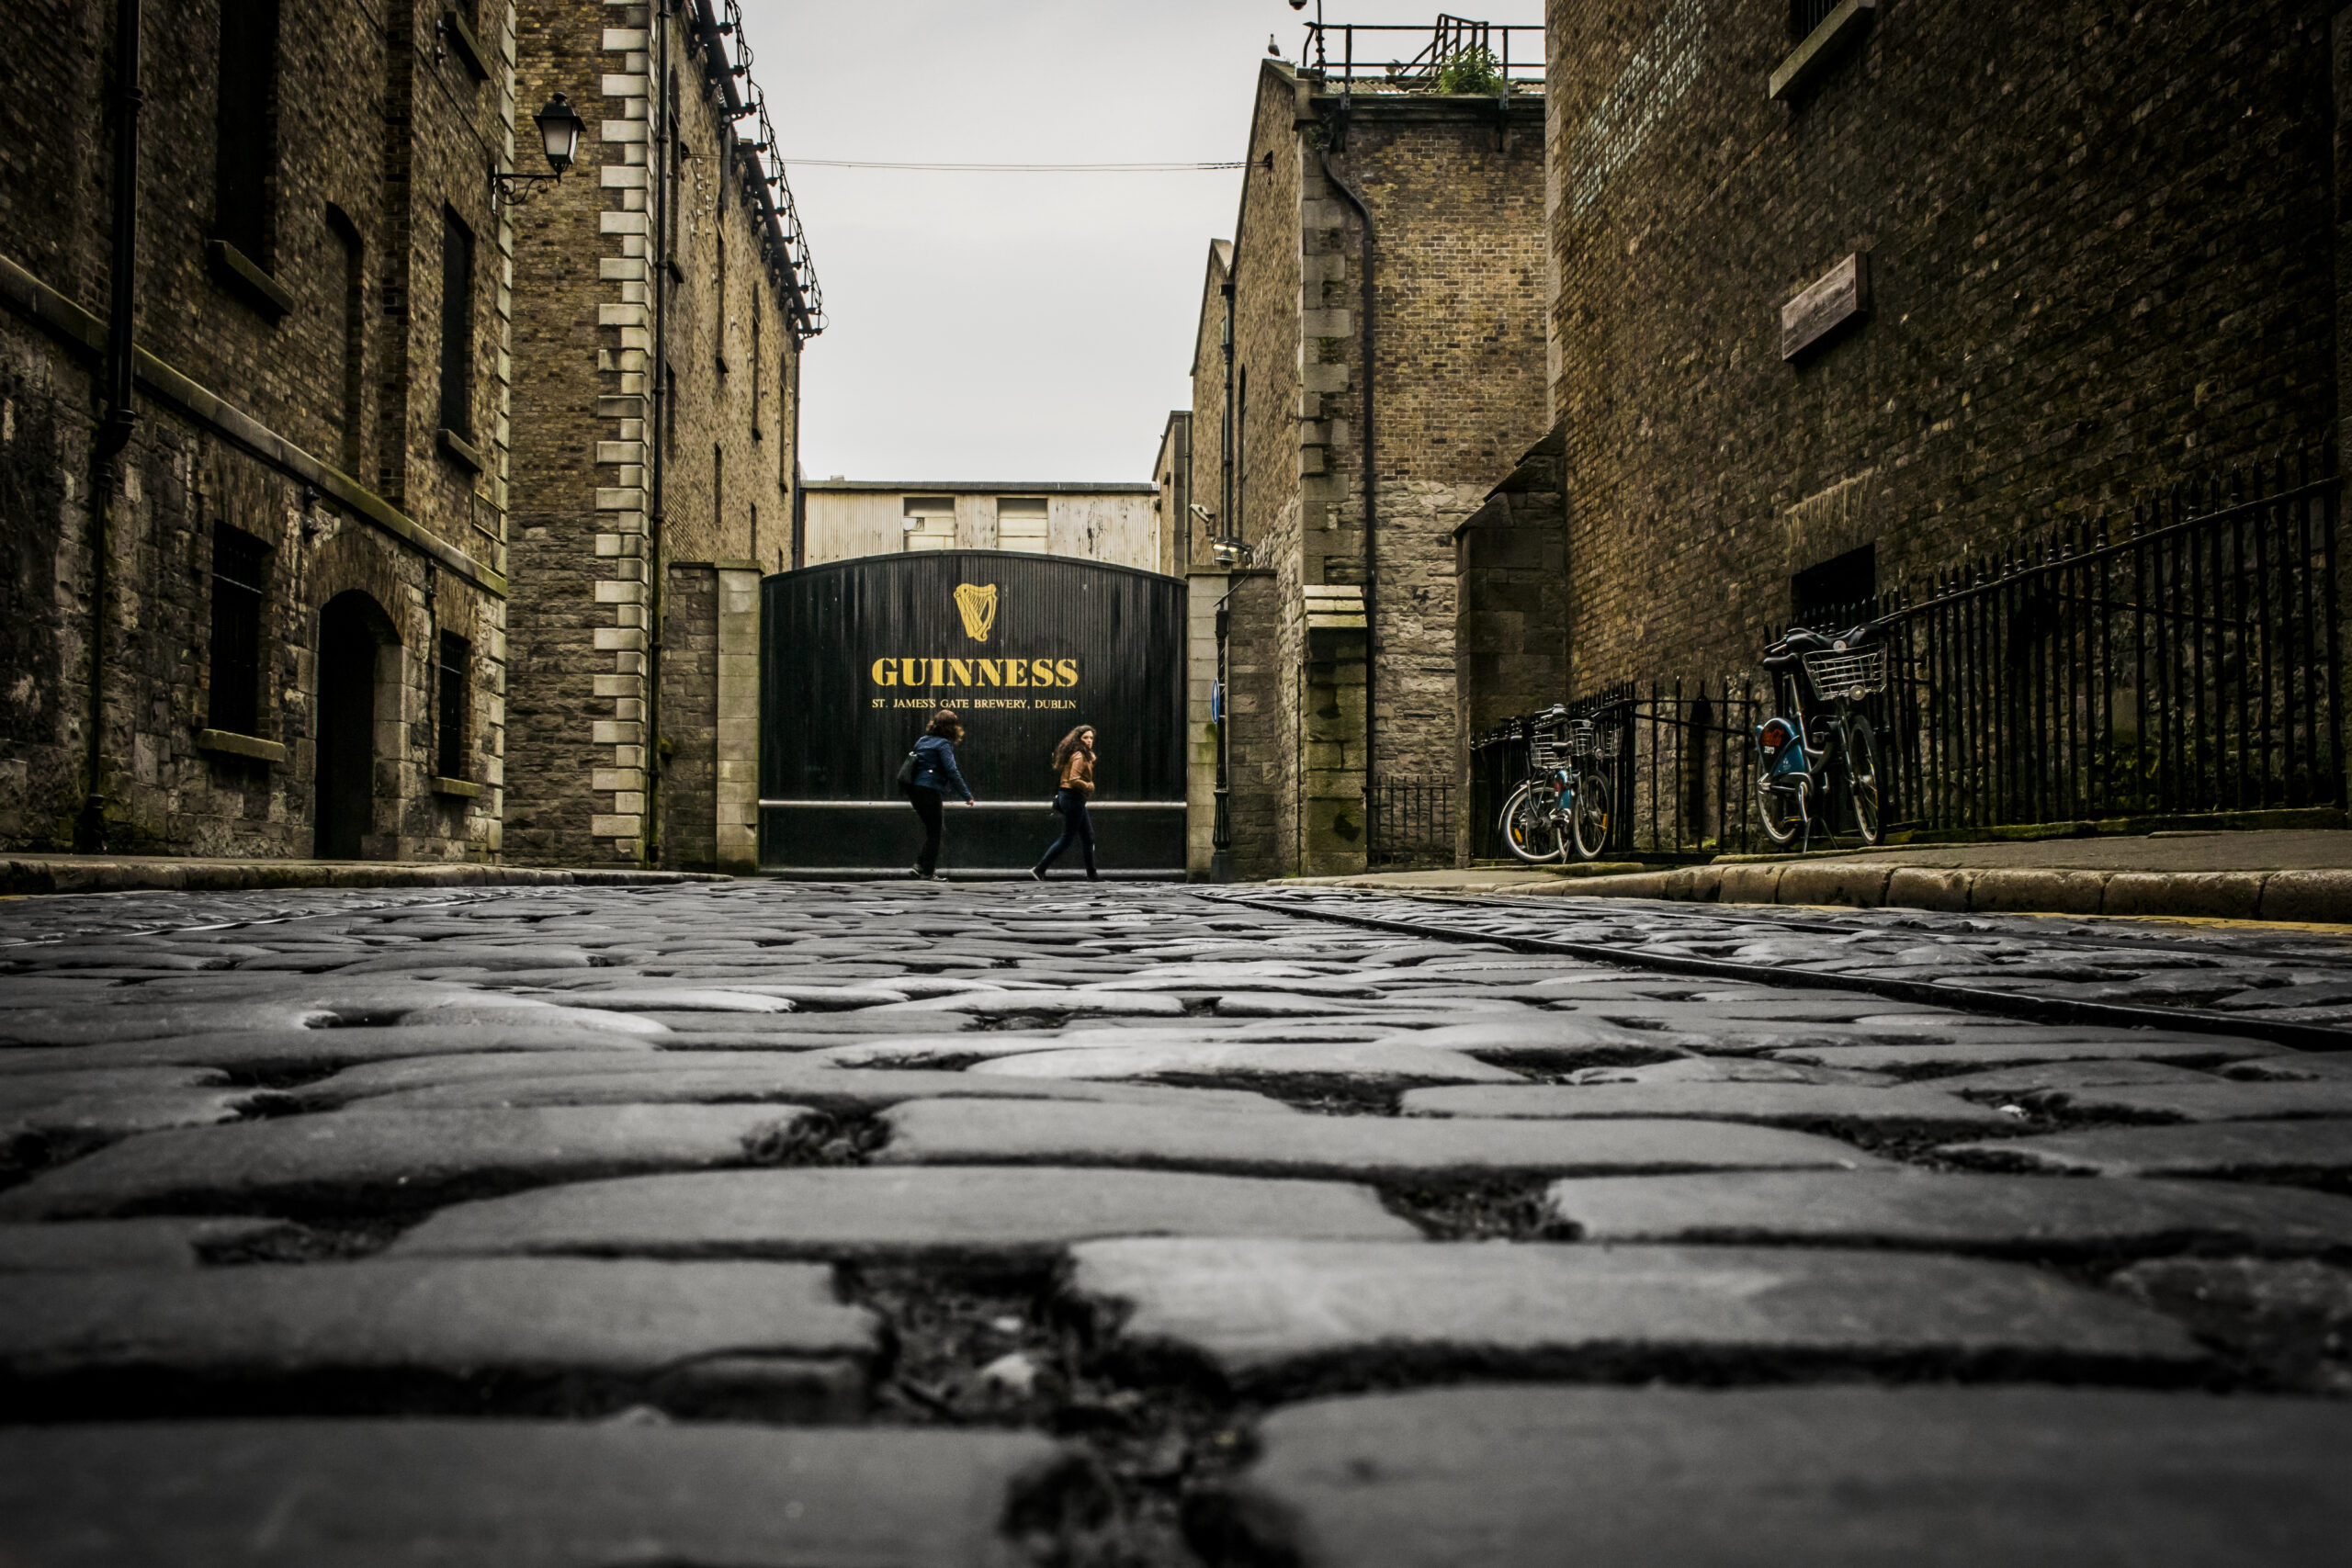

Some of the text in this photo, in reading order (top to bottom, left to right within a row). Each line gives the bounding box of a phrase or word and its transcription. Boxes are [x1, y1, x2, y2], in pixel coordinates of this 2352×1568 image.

[871, 658, 1078, 687] GUINNESS
[872, 698, 1077, 710] ST. JAMES'S GATE BREWERY, DUBLIN
